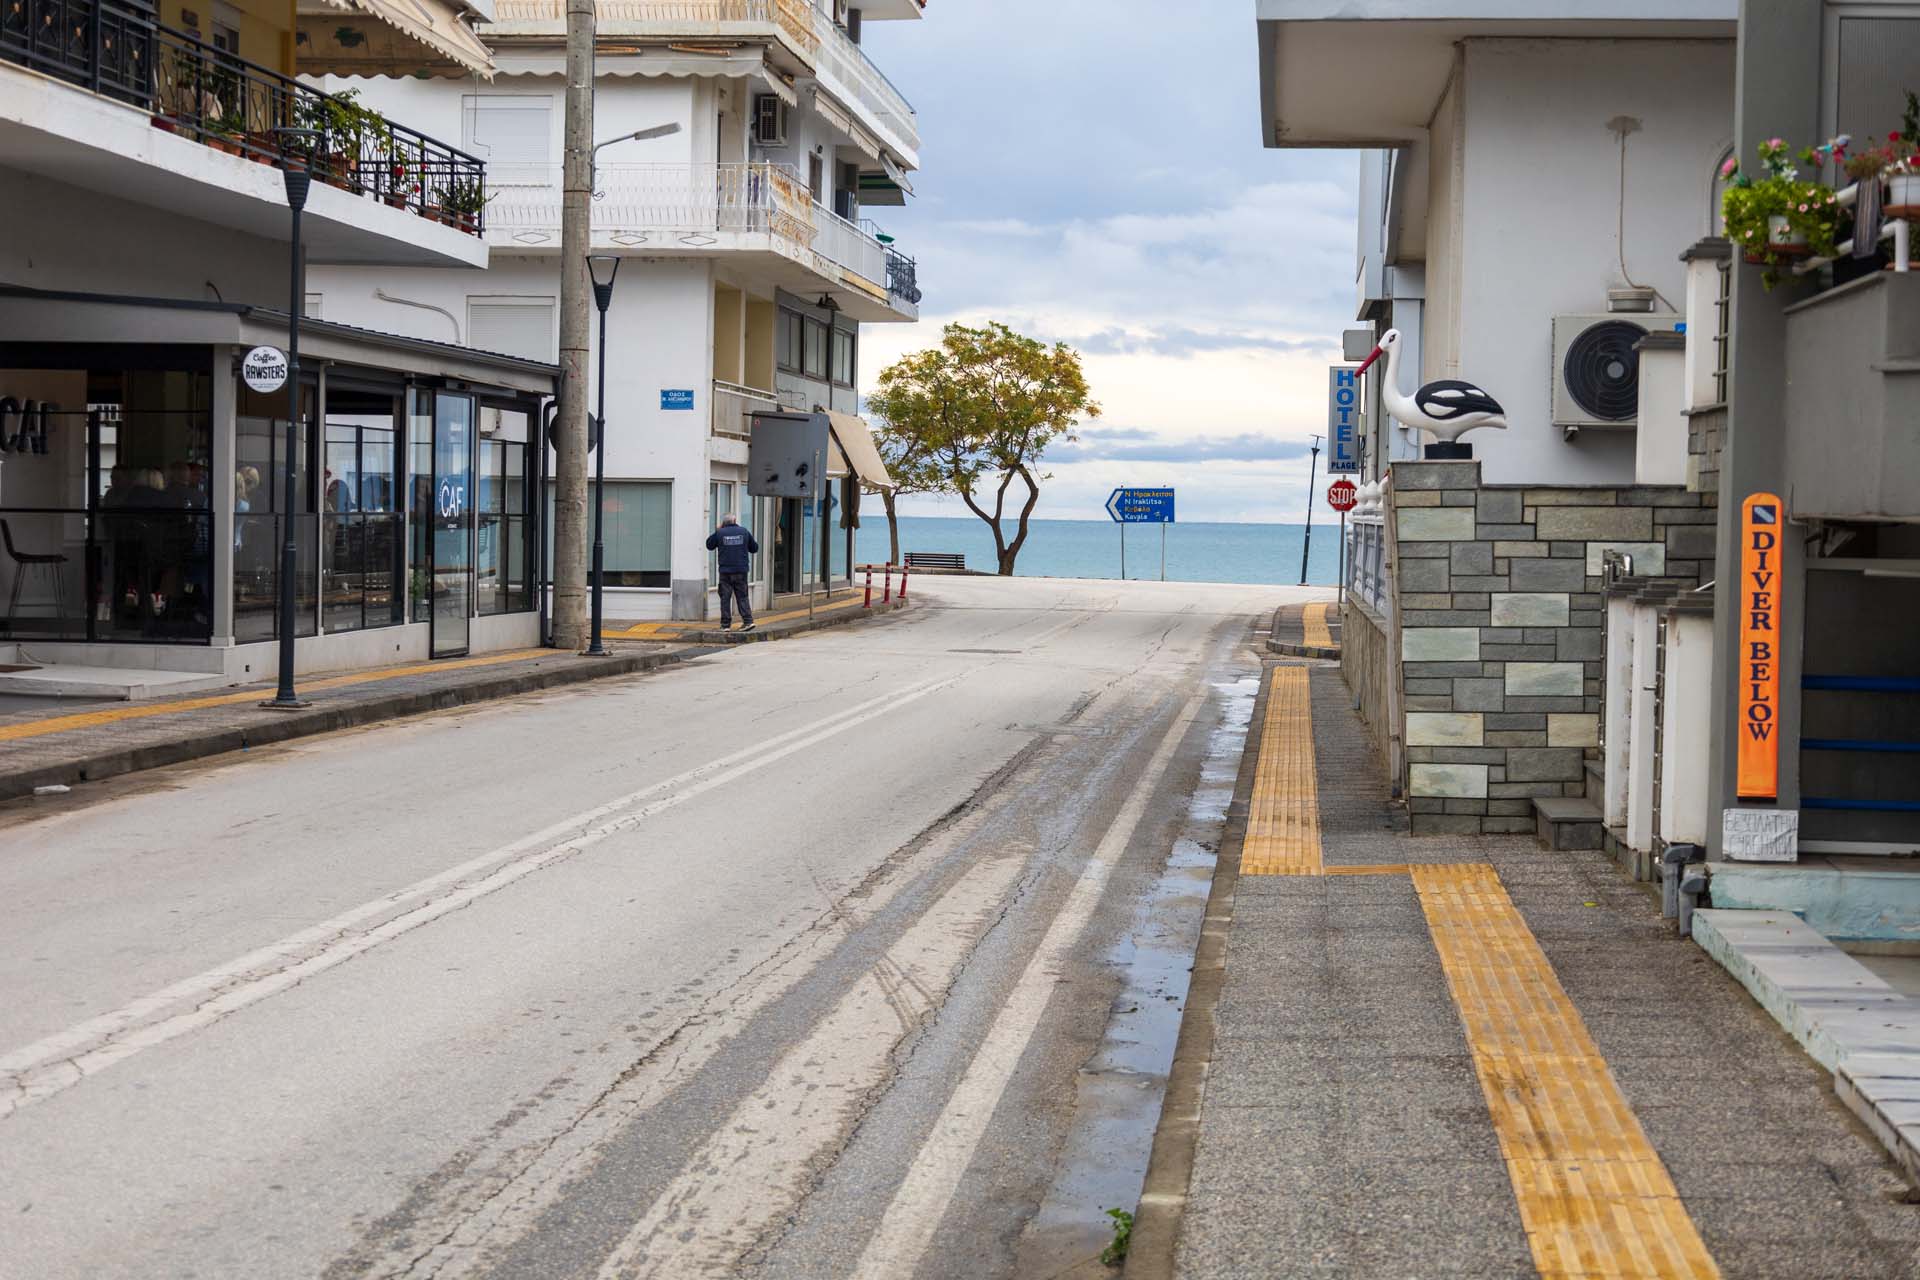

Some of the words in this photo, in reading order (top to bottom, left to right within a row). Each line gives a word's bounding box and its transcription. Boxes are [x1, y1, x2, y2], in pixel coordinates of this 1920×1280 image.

[252, 353, 277, 364] Coffee
[245, 363, 286, 380] RAWSTERS
[1336, 370, 1354, 460] HOTEL
[1331, 462, 1356, 470] PLAGE
[441, 485, 464, 518] CAF
[1329, 487, 1356, 505] STOP
[1750, 531, 1776, 630] DIVER
[1748, 642, 1773, 742] BELOW
